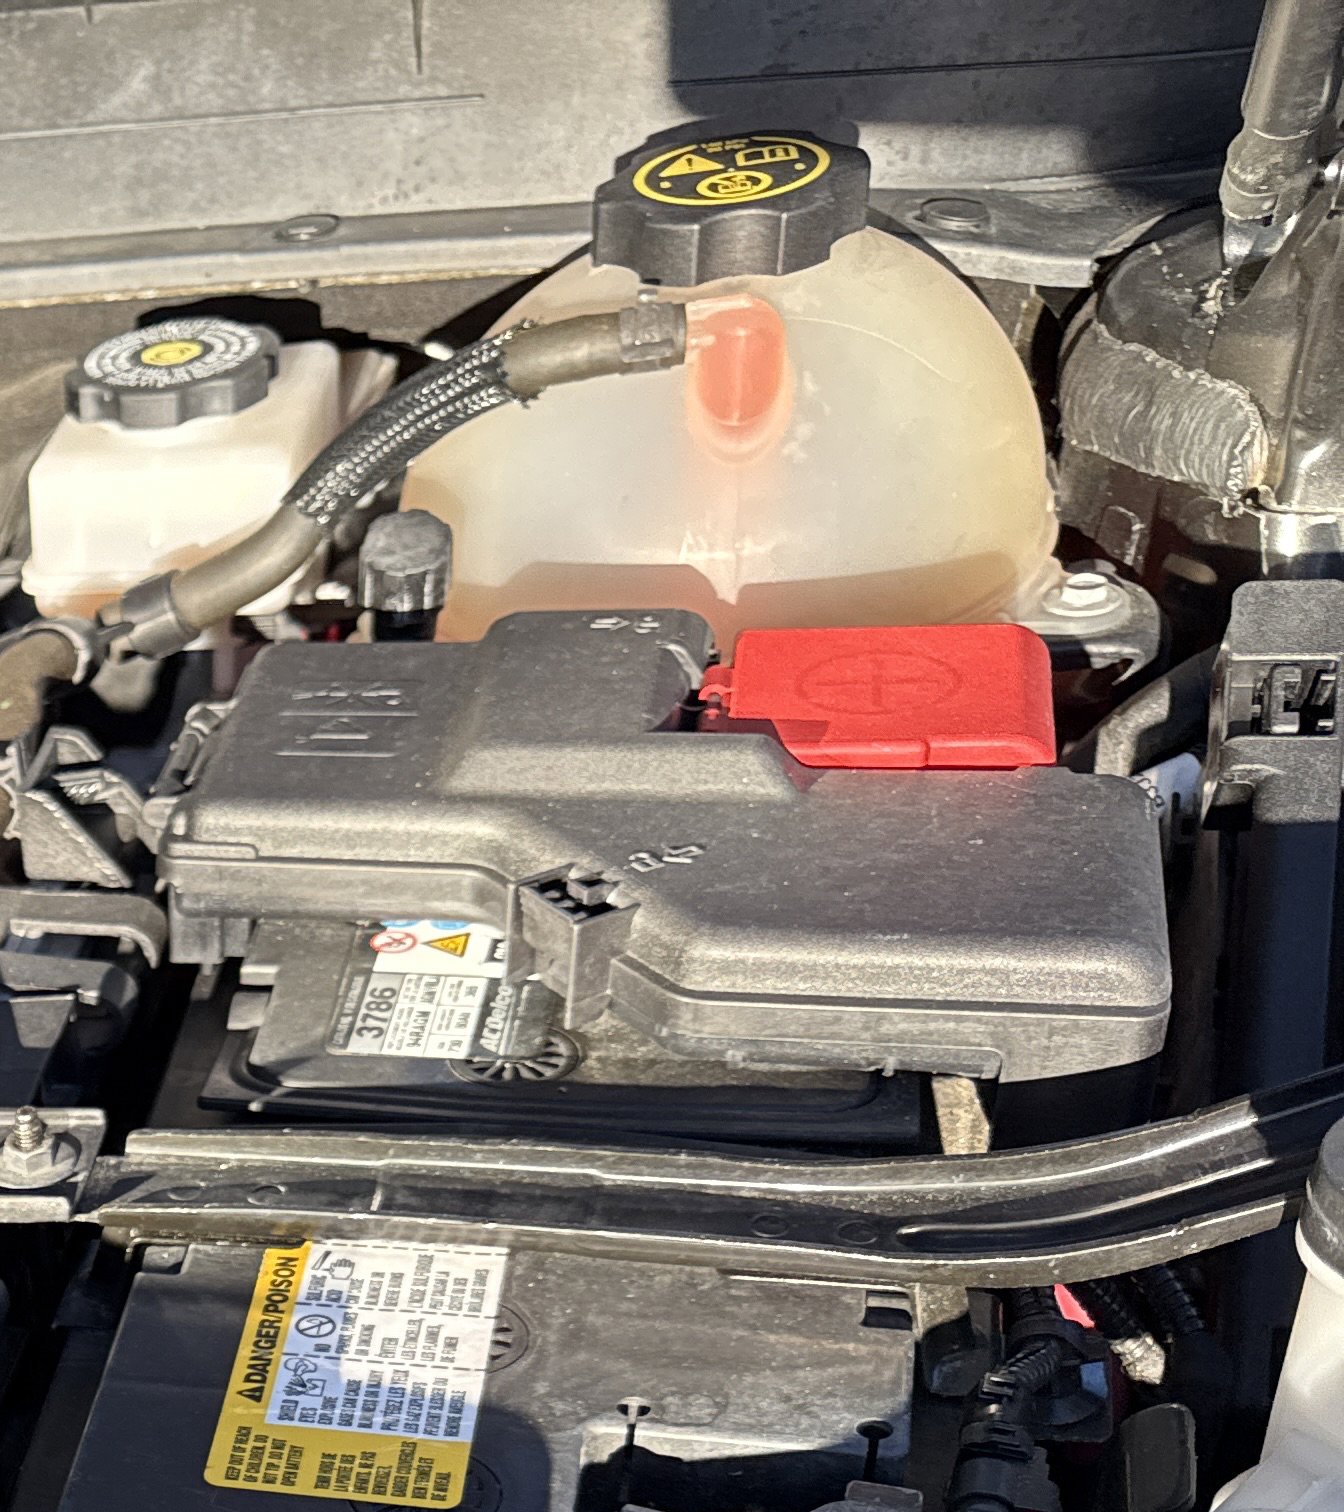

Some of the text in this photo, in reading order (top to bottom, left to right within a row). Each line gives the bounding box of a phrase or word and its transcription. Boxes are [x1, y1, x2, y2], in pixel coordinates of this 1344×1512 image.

[356, 986, 398, 1038] 3786
[479, 985, 514, 1053] ACDelco
[242, 1256, 299, 1384] DANGER/POISON
